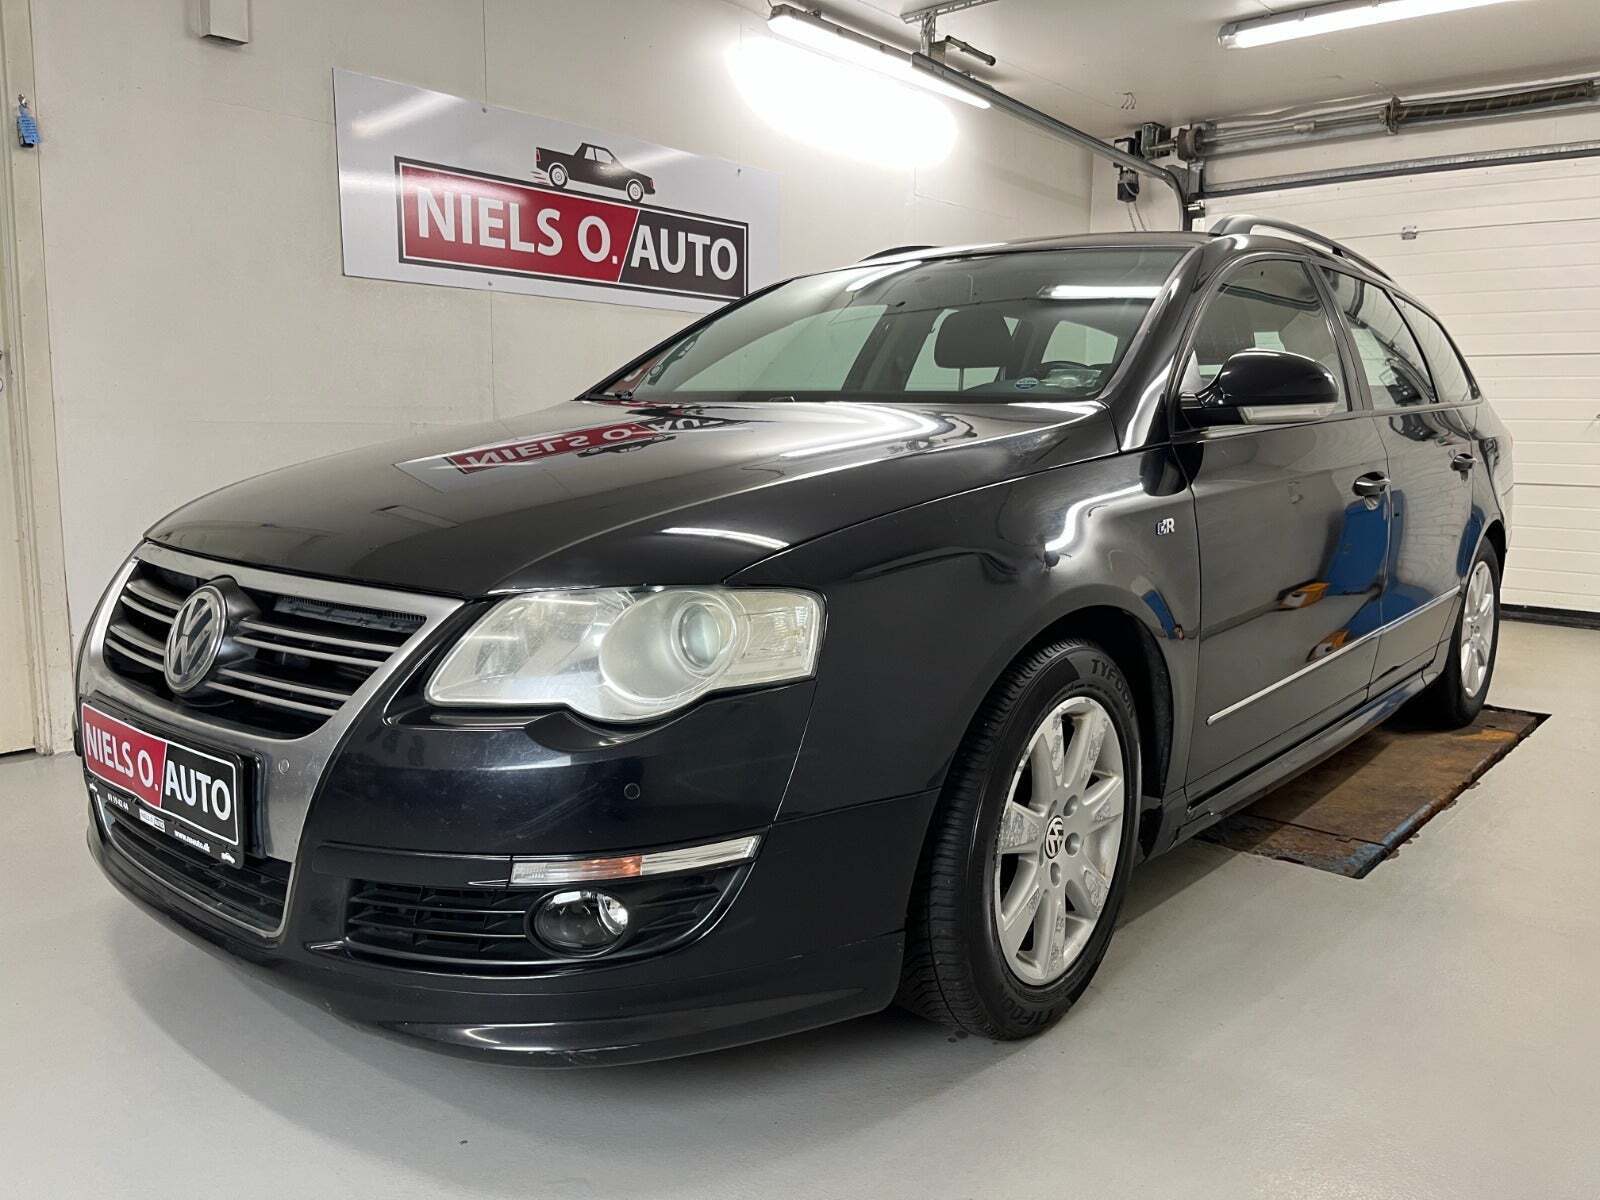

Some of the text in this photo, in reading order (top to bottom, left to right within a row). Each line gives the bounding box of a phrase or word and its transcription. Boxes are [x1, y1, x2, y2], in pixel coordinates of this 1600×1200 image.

[417, 187, 738, 281] NIELS O. AUTO
[85, 721, 134, 778] NIELS
[137, 749, 159, 791] O.
[165, 759, 232, 821] AUTO
